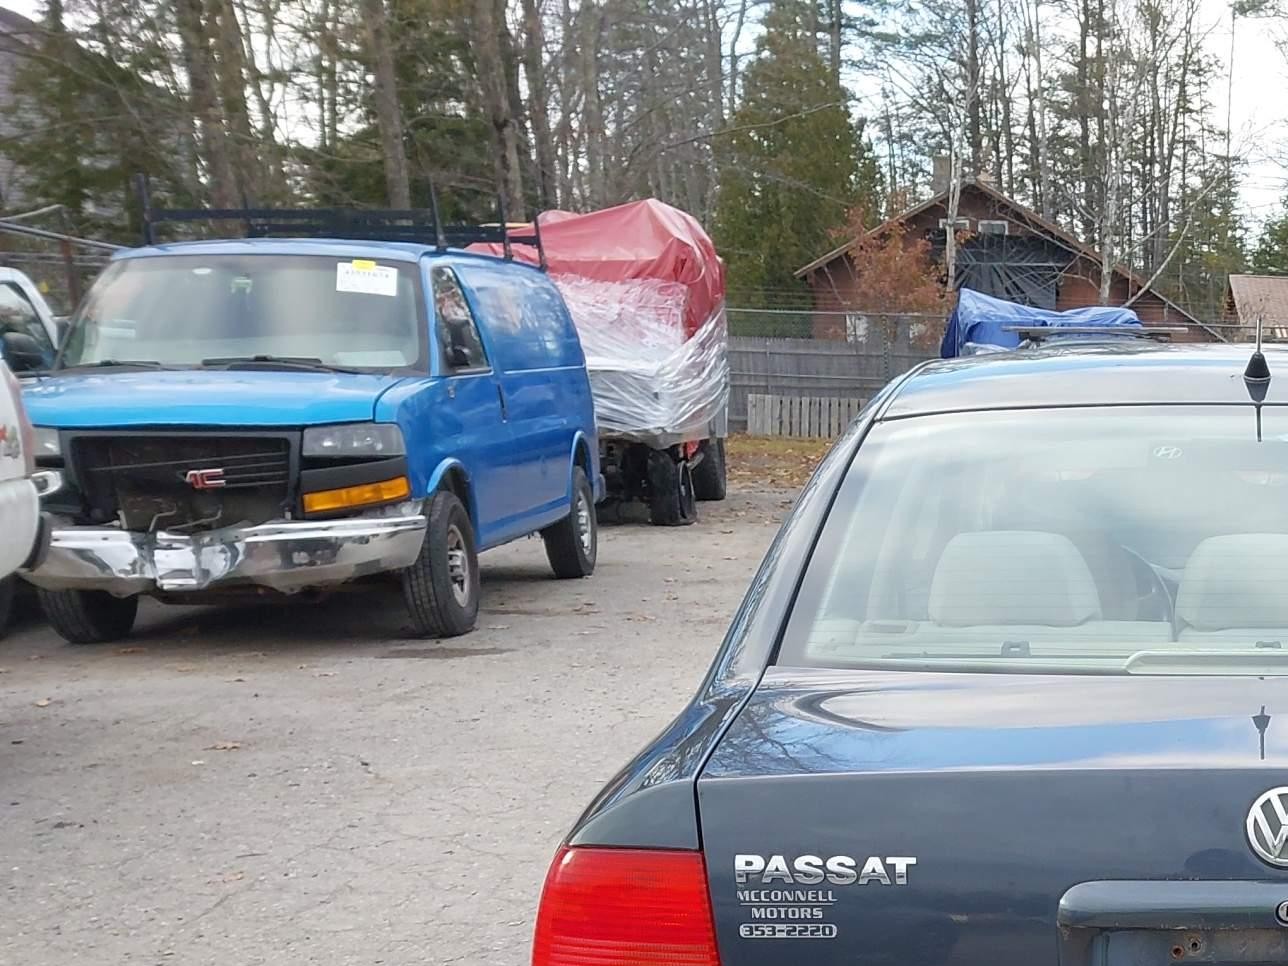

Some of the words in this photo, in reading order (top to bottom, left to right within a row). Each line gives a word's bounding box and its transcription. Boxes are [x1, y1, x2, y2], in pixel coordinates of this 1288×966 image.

[734, 854, 917, 885] PASSAT
[736, 890, 838, 902] MCCONNELL
[751, 907, 823, 919] MOTORS
[741, 924, 836, 937] 353-2220
